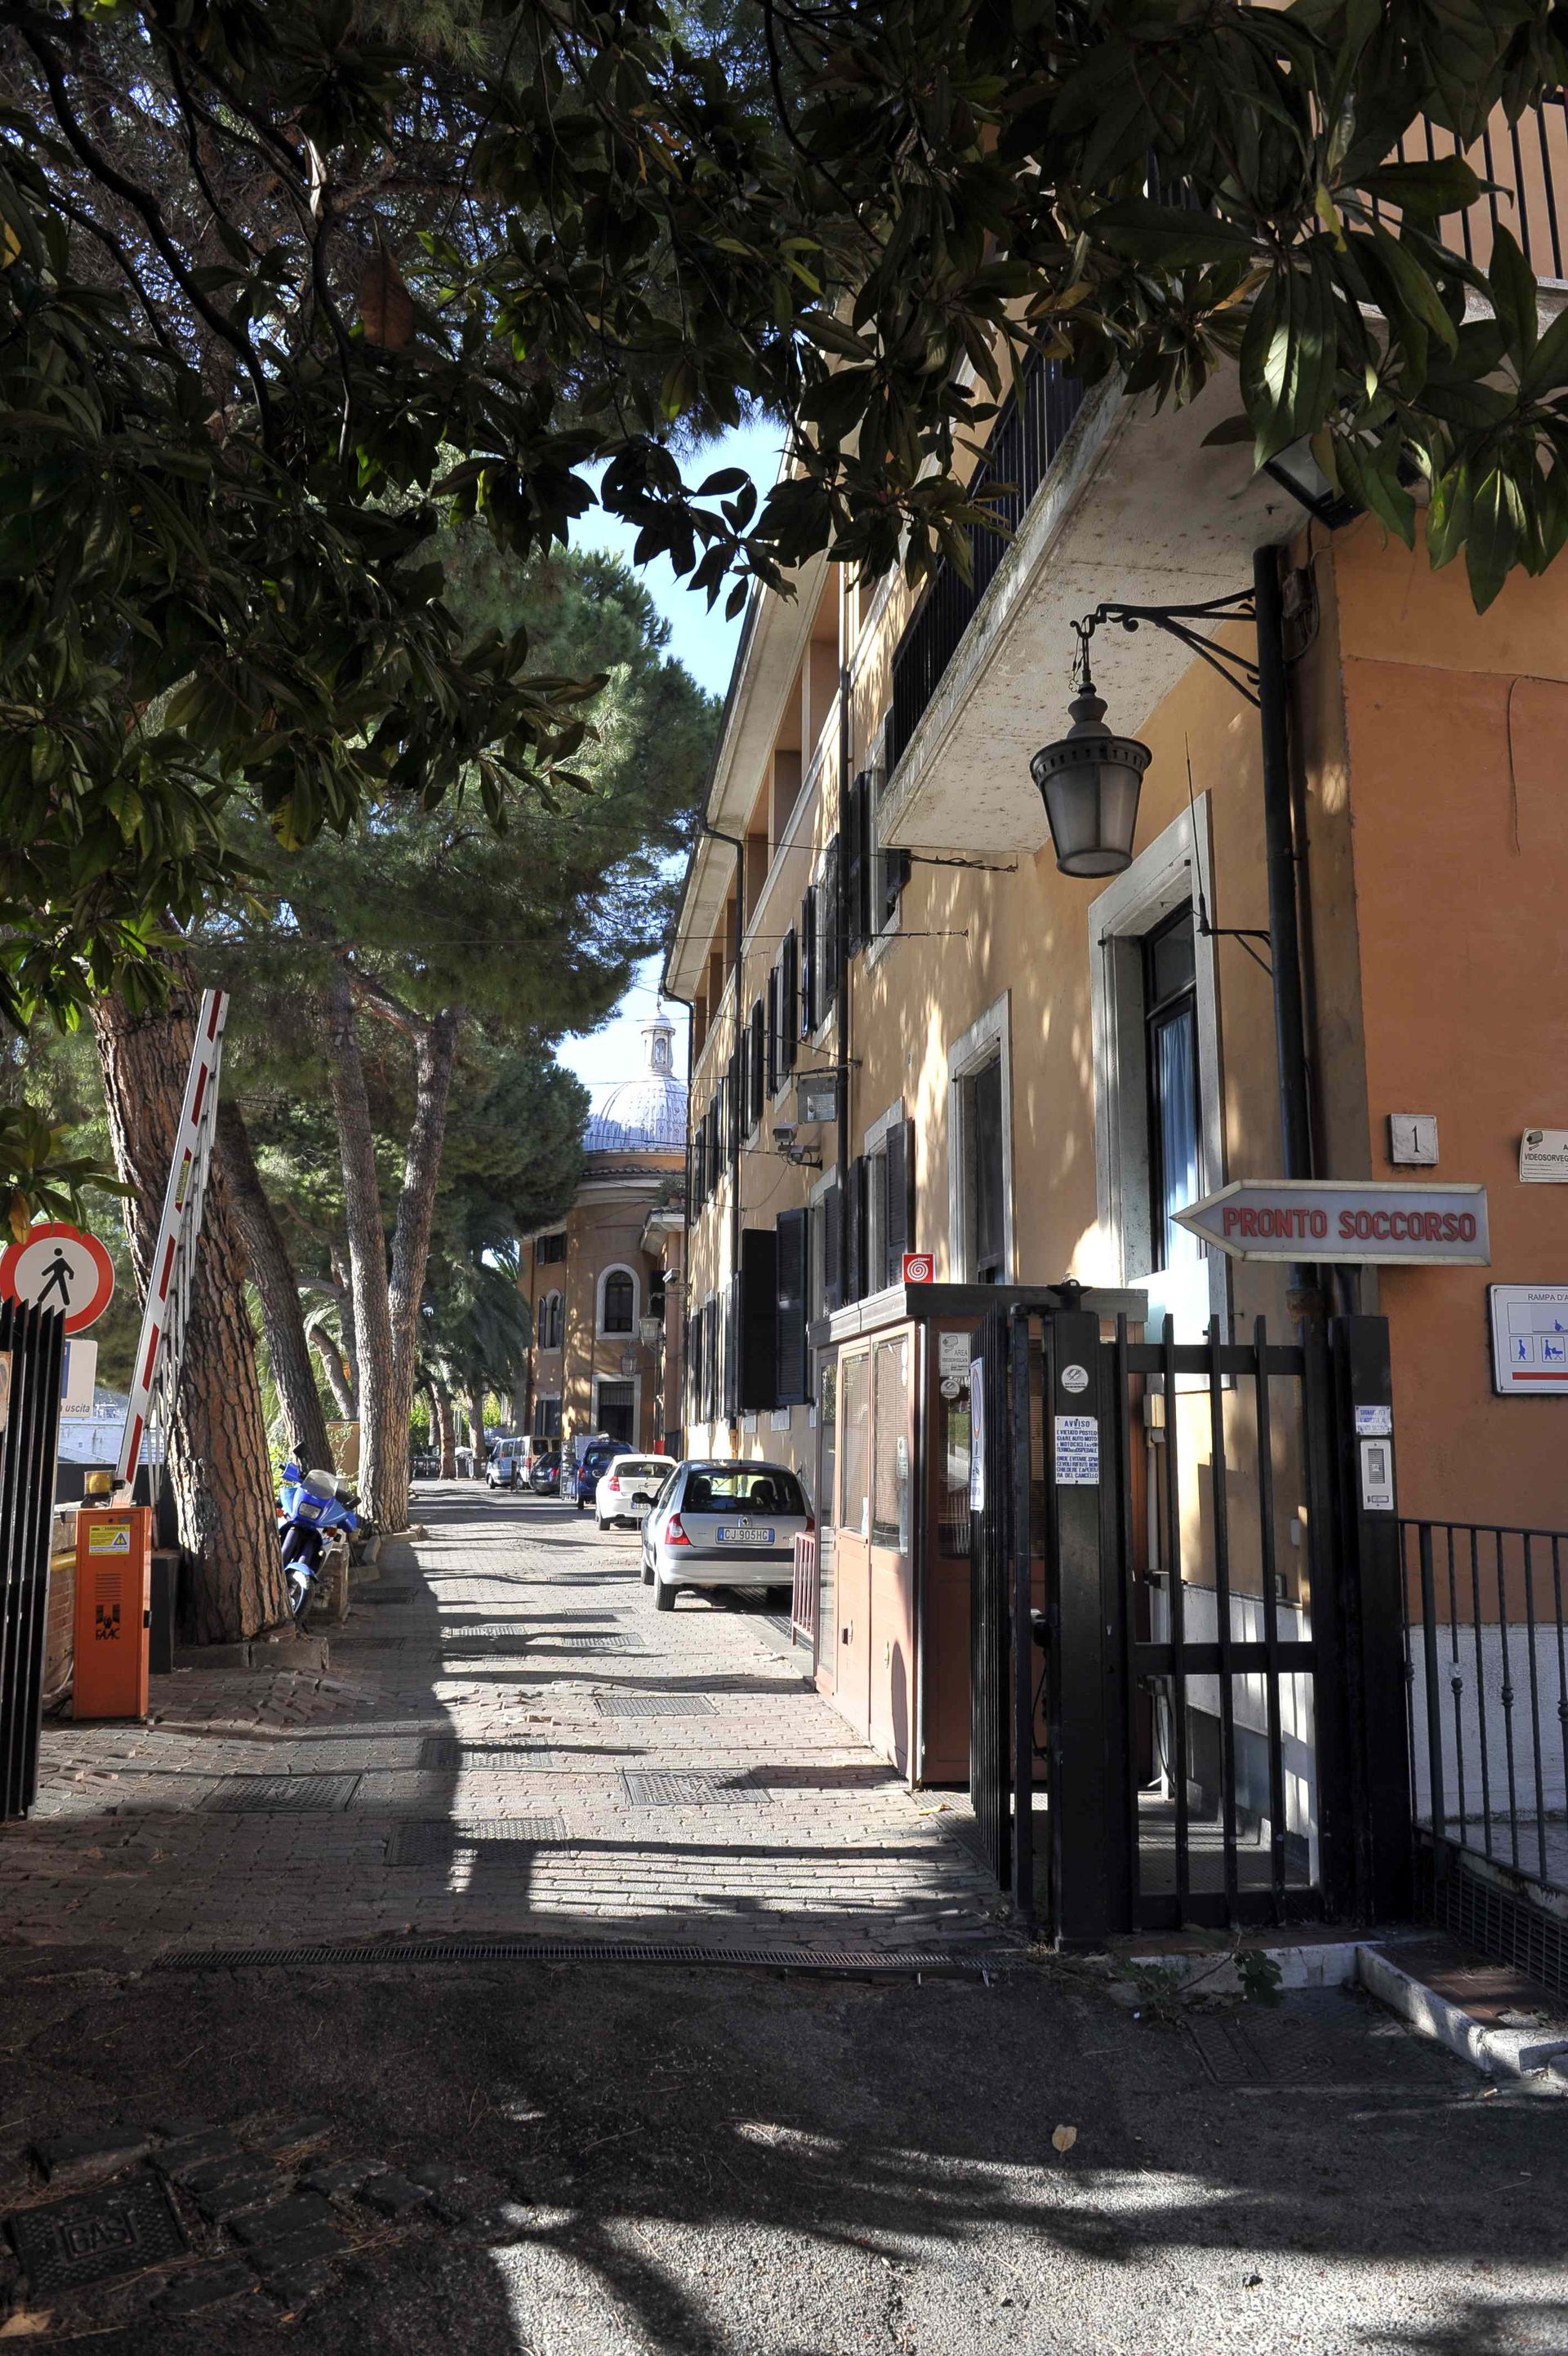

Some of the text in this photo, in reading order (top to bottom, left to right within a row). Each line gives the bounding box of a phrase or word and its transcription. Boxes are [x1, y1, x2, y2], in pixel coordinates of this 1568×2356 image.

[1410, 1125, 1420, 1153] 1
[1223, 1207, 1477, 1242] PRONTO SOCCORSO
[65, 1404, 91, 1413] uscita
[96, 1628, 121, 1641] FAAC
[68, 2216, 127, 2253] GAS
